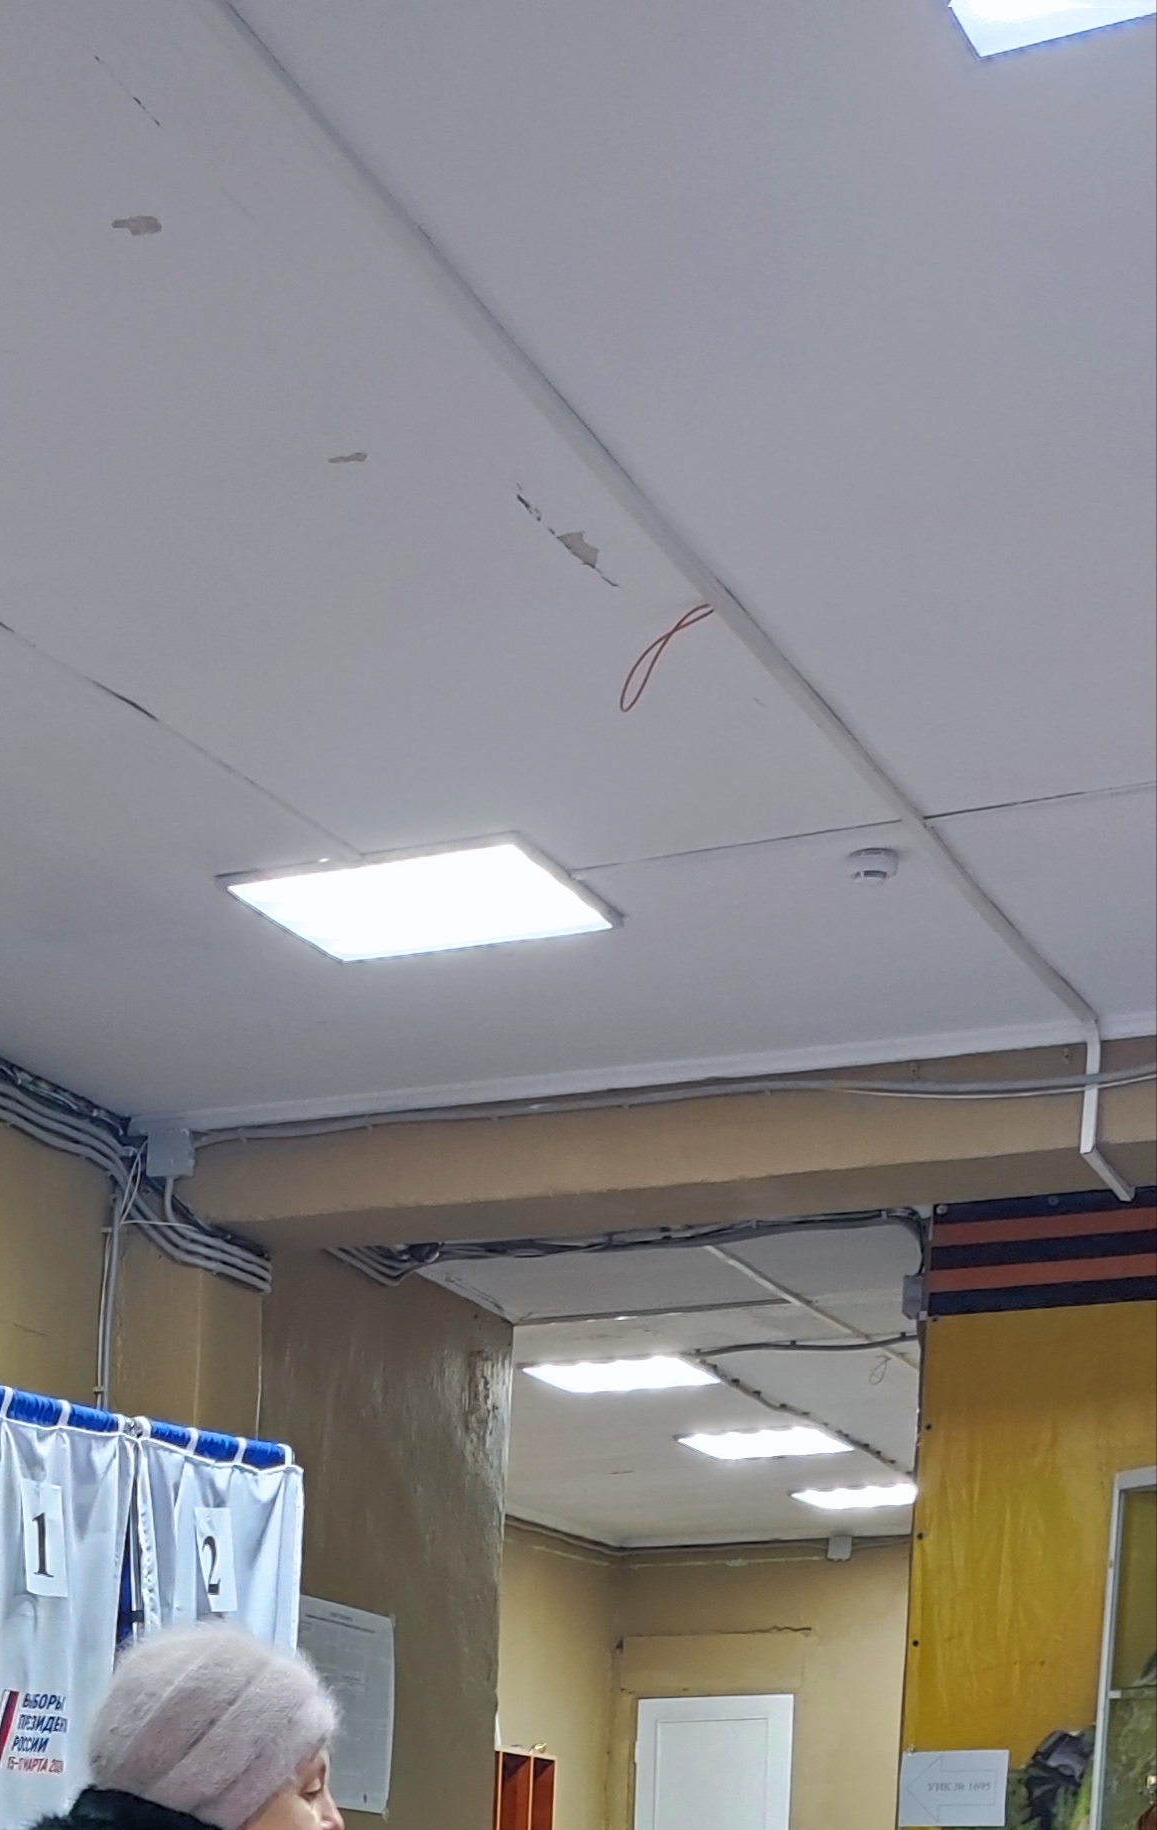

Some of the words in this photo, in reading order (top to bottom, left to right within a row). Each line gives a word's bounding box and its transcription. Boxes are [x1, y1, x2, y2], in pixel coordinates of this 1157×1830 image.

[31, 1512, 55, 1578] 1
[202, 1535, 221, 1596] 2
[11, 1735, 49, 1753] РОССИИ
